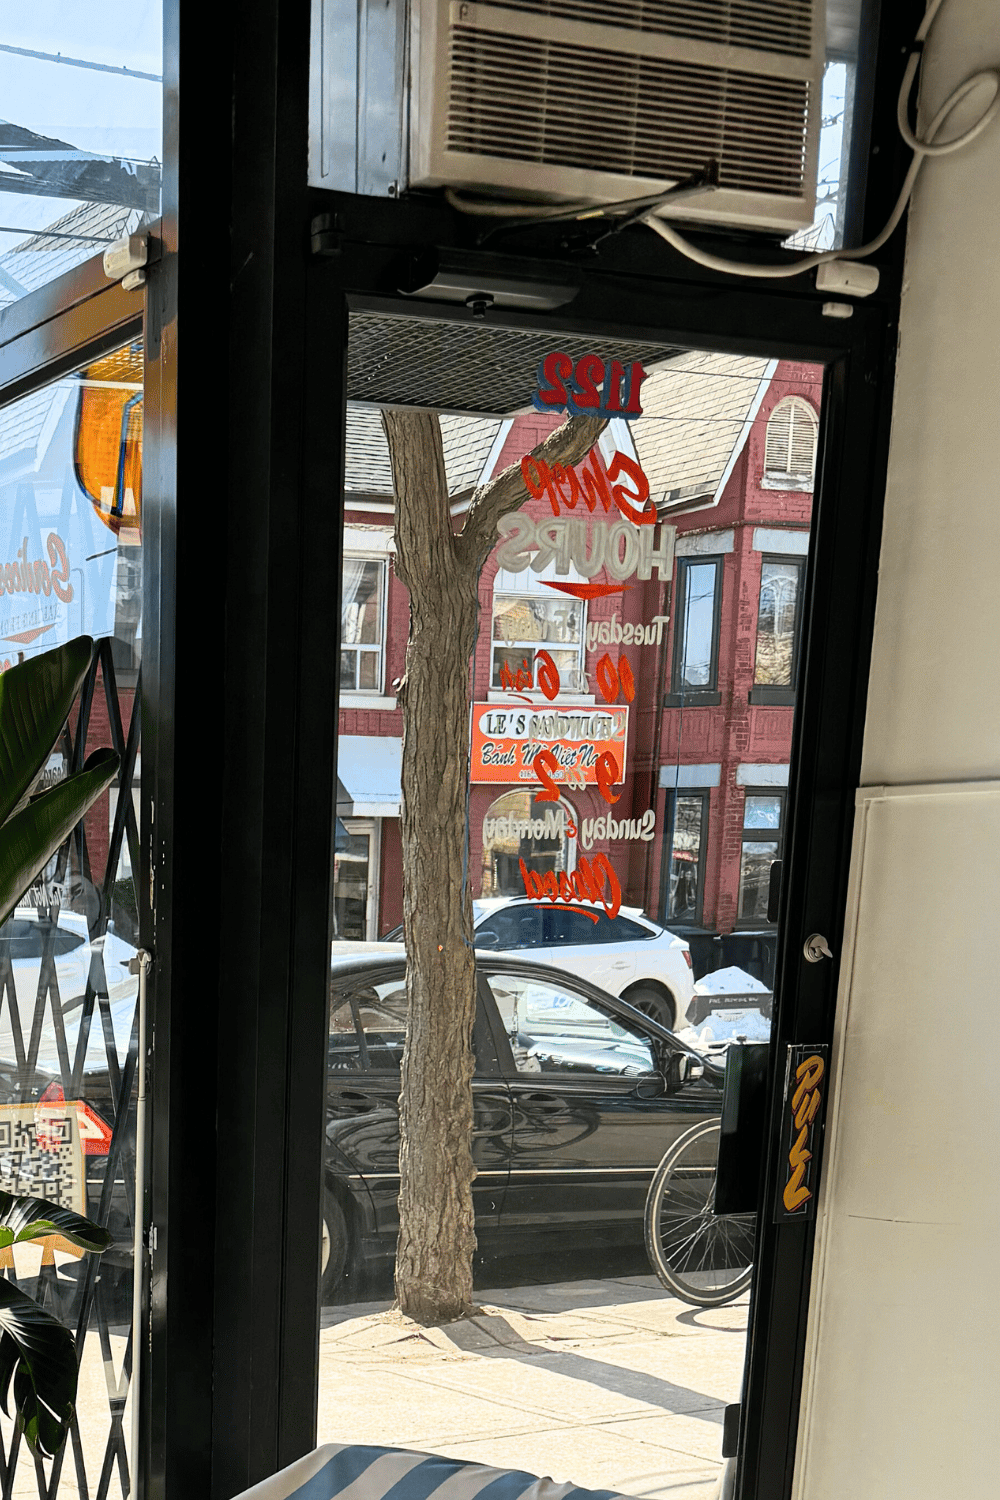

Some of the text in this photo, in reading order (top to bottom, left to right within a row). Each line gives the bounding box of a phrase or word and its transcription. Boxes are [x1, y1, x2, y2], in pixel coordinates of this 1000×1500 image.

[485, 714, 526, 735] LE'S
[481, 742, 517, 766] Bánh
[783, 1054, 825, 1213] PULL
